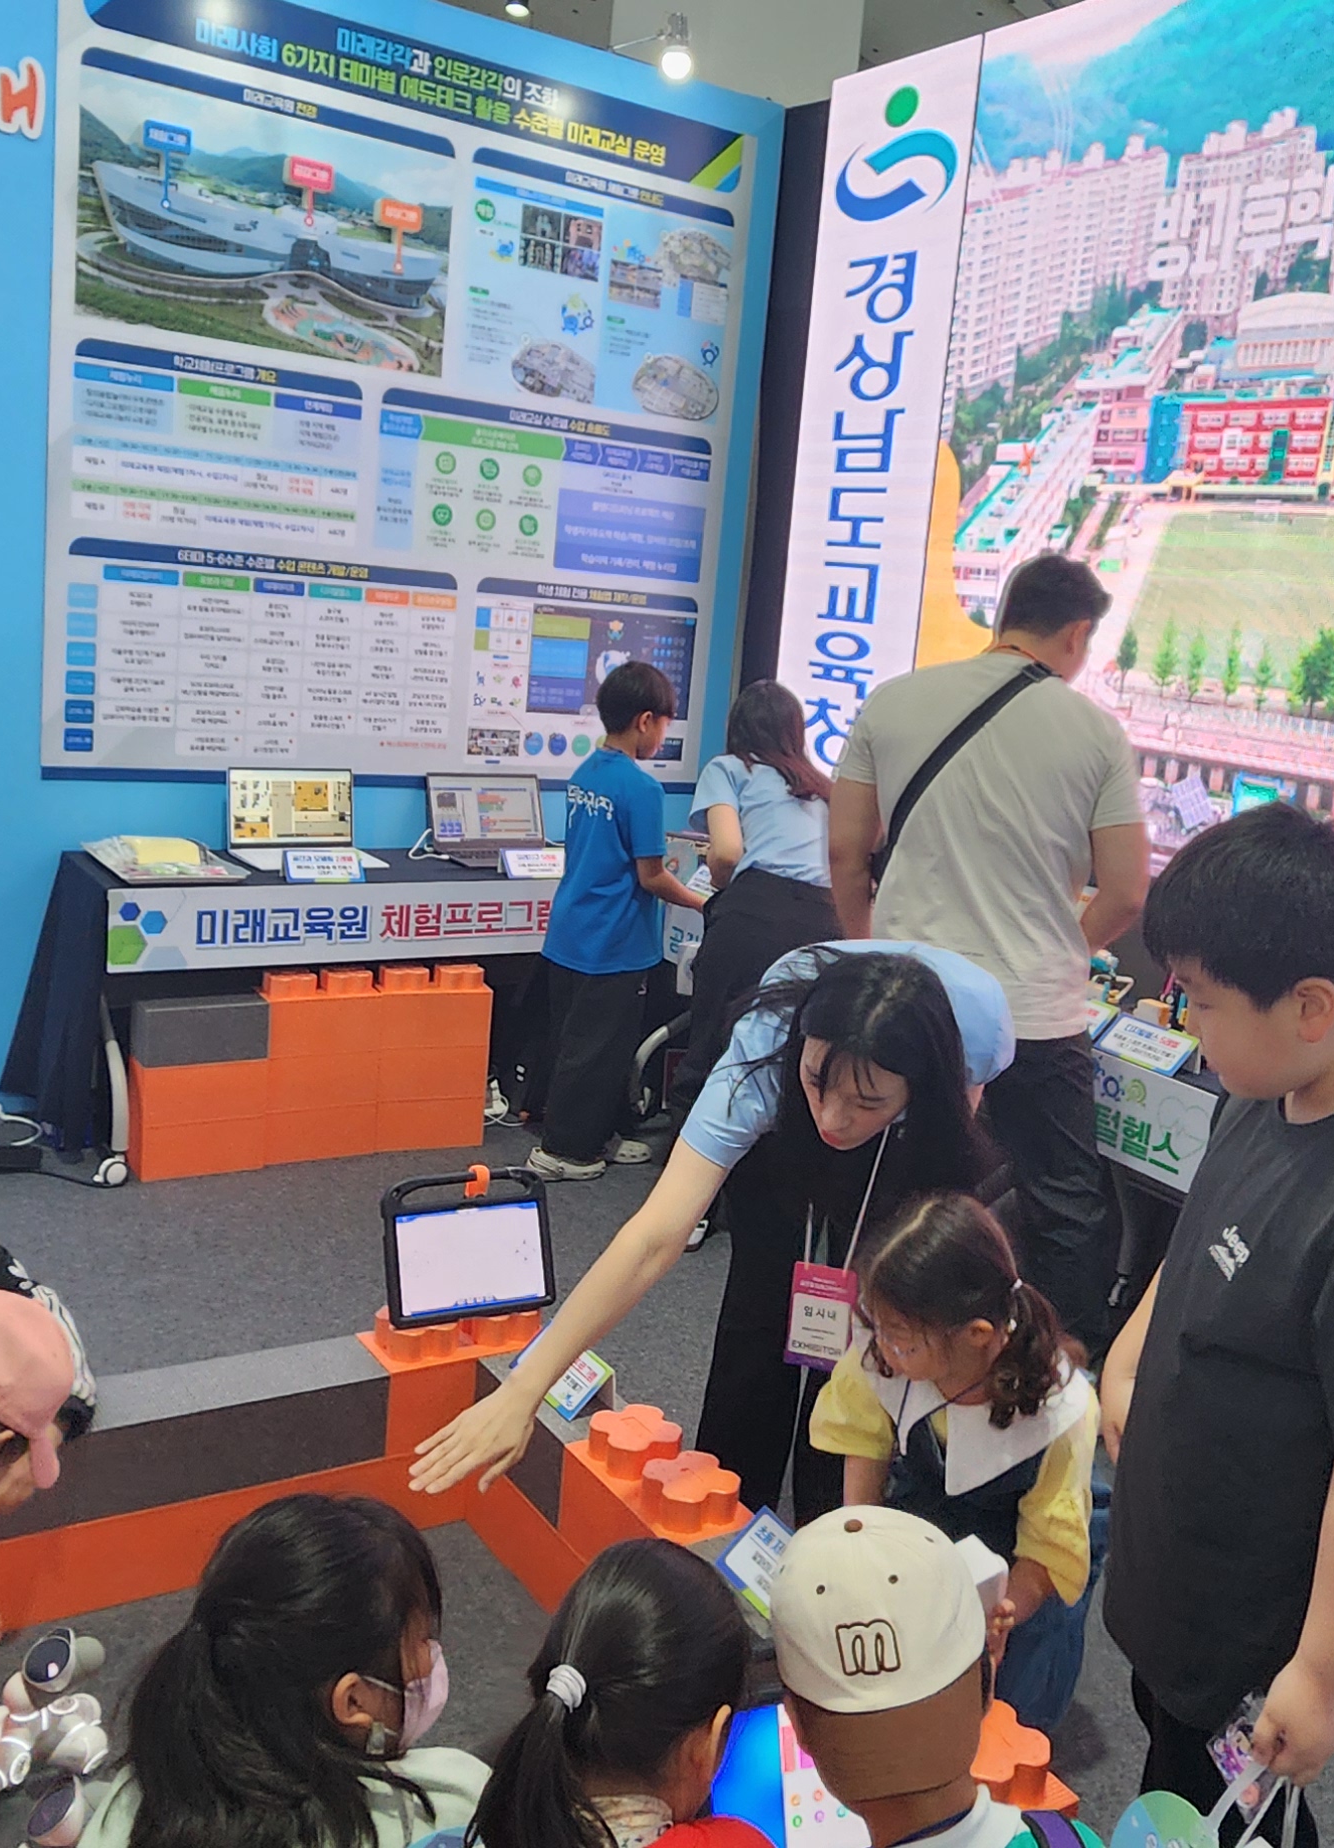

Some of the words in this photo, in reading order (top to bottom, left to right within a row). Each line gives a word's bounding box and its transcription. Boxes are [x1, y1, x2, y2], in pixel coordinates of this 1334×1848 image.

[336, 27, 432, 75] 미래감각과
[195, 17, 278, 63] 미래사회
[281, 43, 335, 78] 6가지
[339, 57, 396, 94] 테마별
[567, 121, 632, 158] 미래교실
[633, 138, 666, 167] 운영
[803, 249, 919, 767] 경상남도교육청
[195, 904, 369, 946] 미래교육원
[1222, 1225, 1250, 1264] Jeep
[835, 1618, 901, 1677] m
